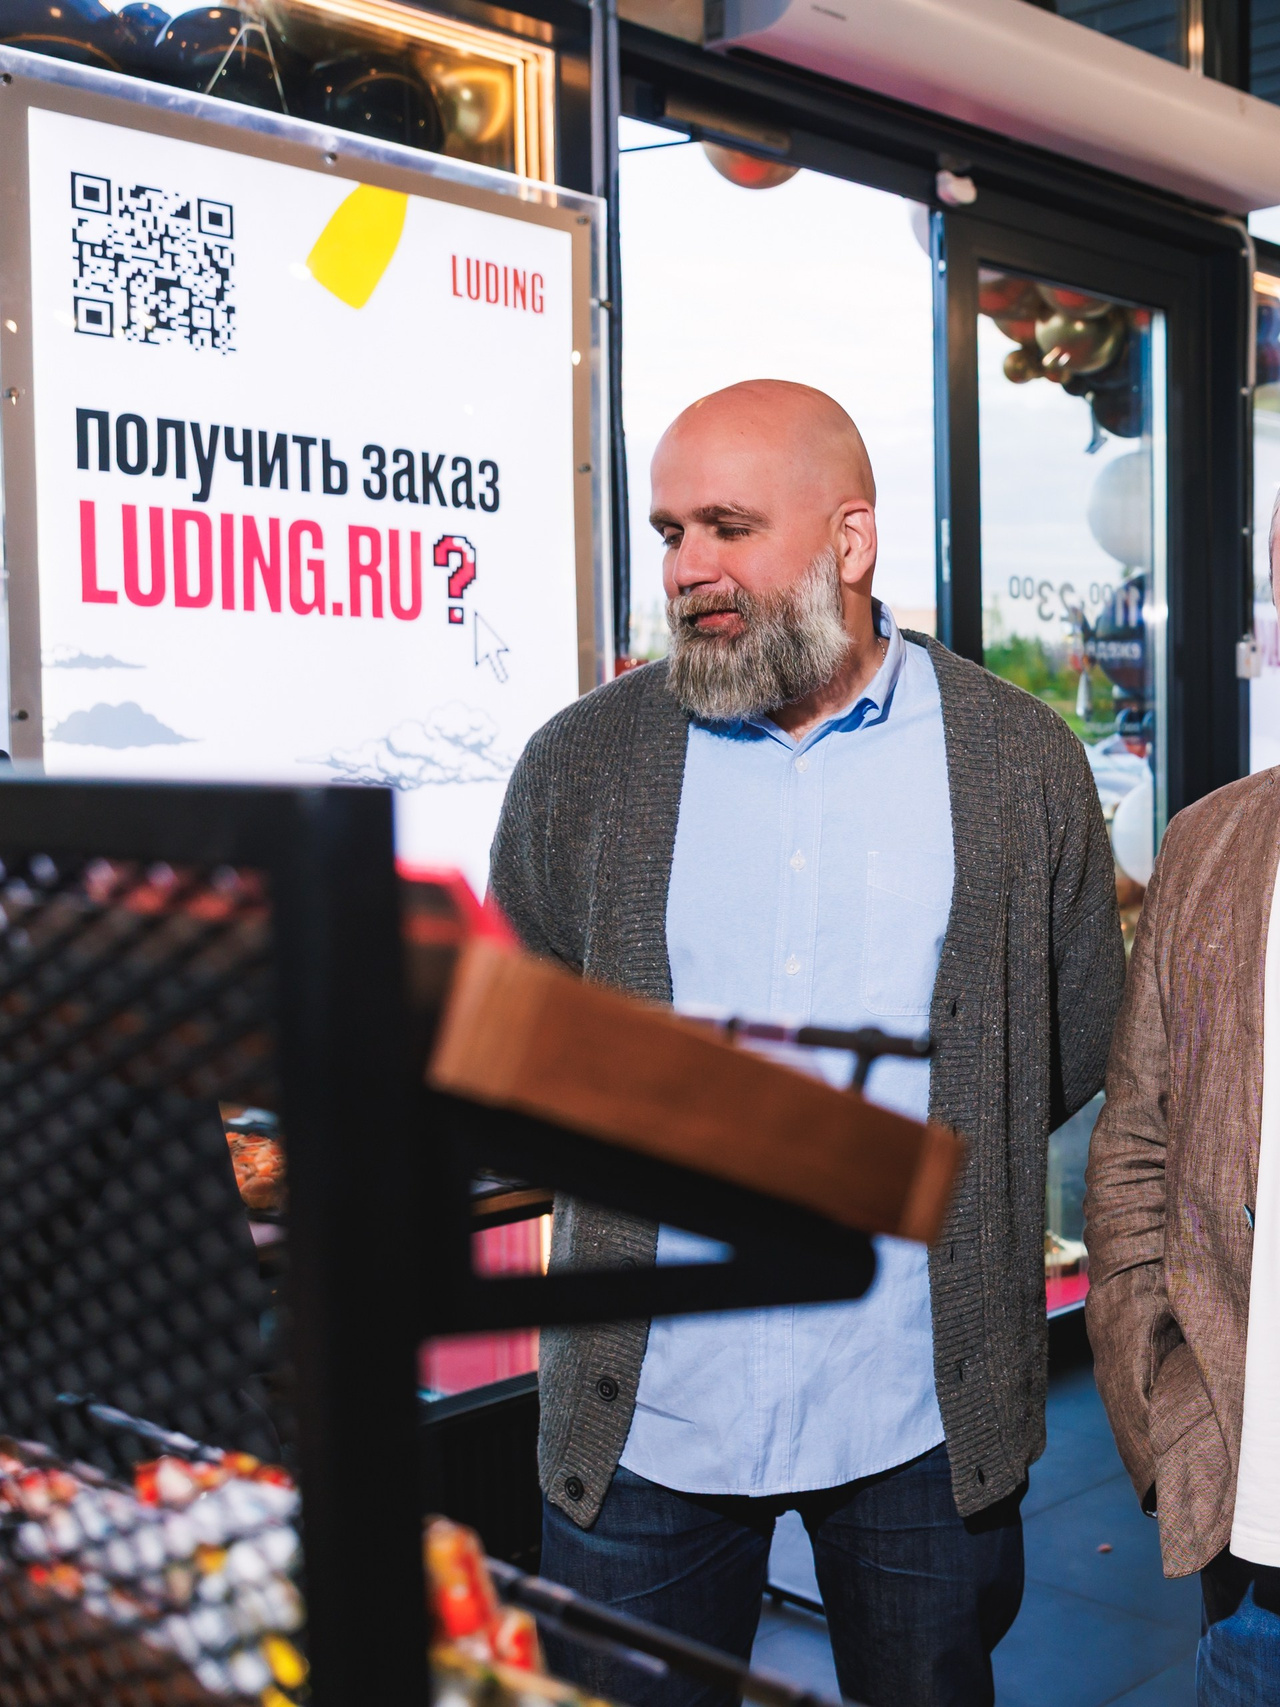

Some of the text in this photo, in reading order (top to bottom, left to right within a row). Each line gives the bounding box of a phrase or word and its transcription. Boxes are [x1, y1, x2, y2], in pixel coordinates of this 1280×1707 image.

[452, 254, 544, 314] LUDING
[75, 407, 501, 514] получить заказ
